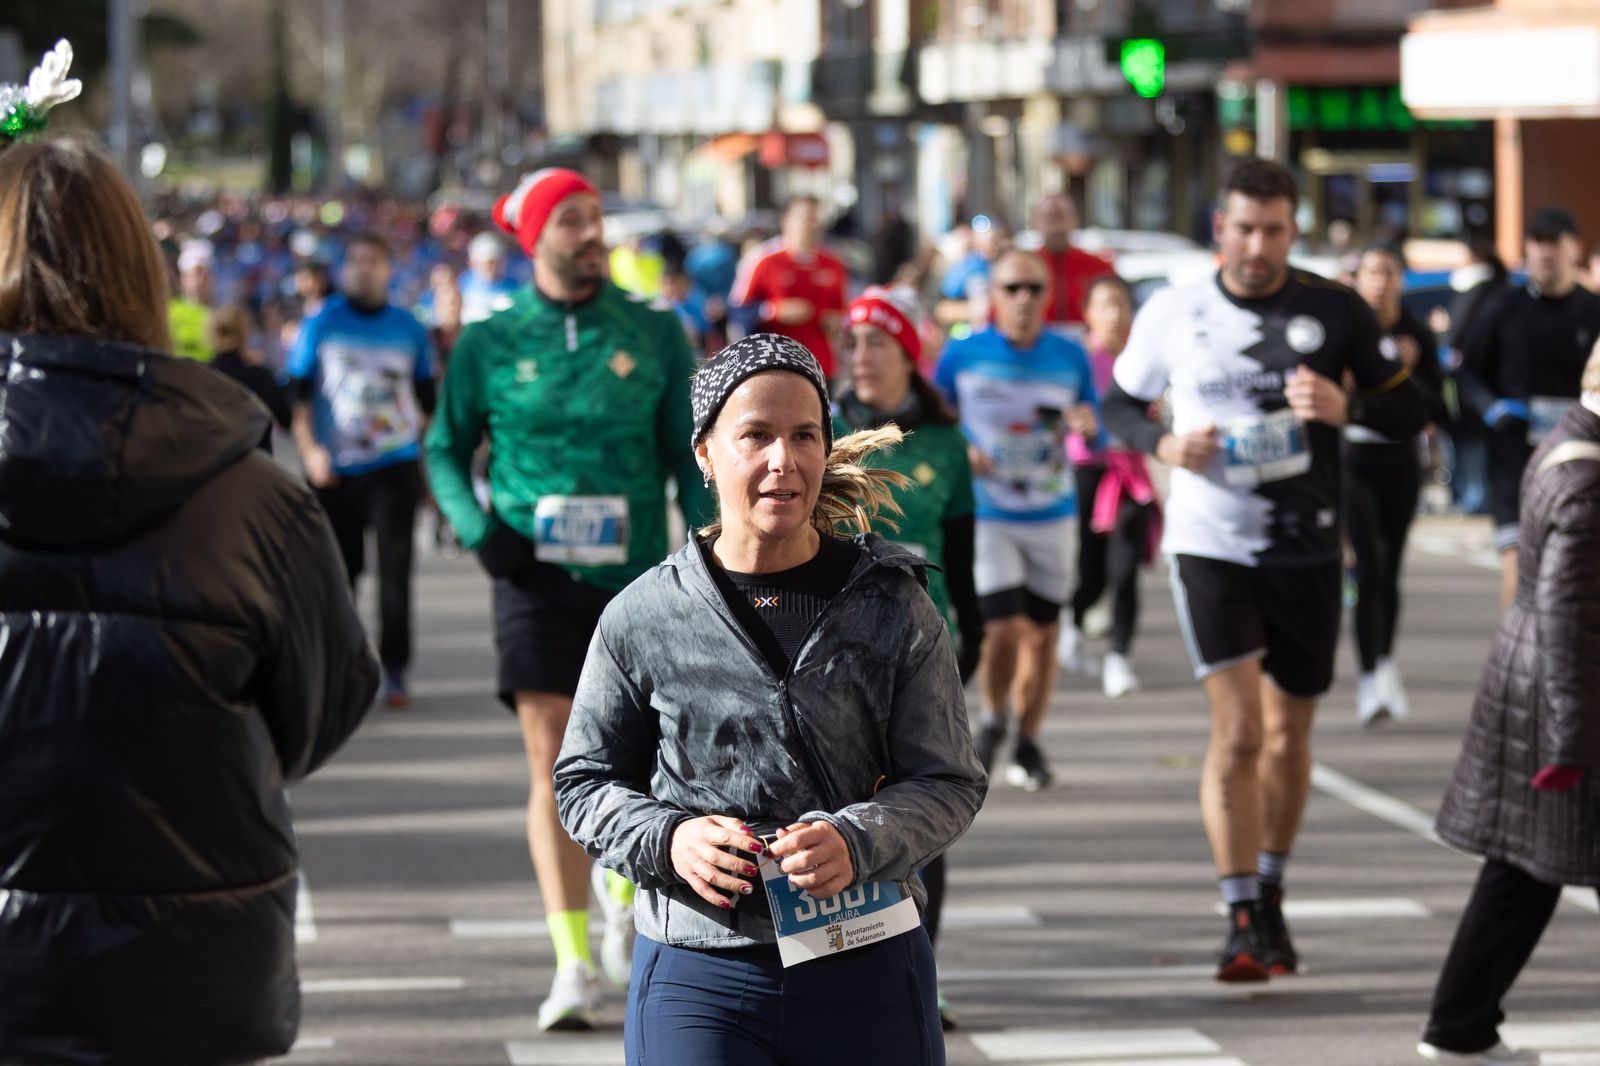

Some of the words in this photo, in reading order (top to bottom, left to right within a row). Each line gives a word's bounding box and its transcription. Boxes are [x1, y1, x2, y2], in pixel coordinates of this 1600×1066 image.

[828, 908, 861, 924] LAURA
[845, 921, 885, 938] Ayuntamiento
[846, 939, 855, 947] de
[855, 931, 887, 945] Salamanca
